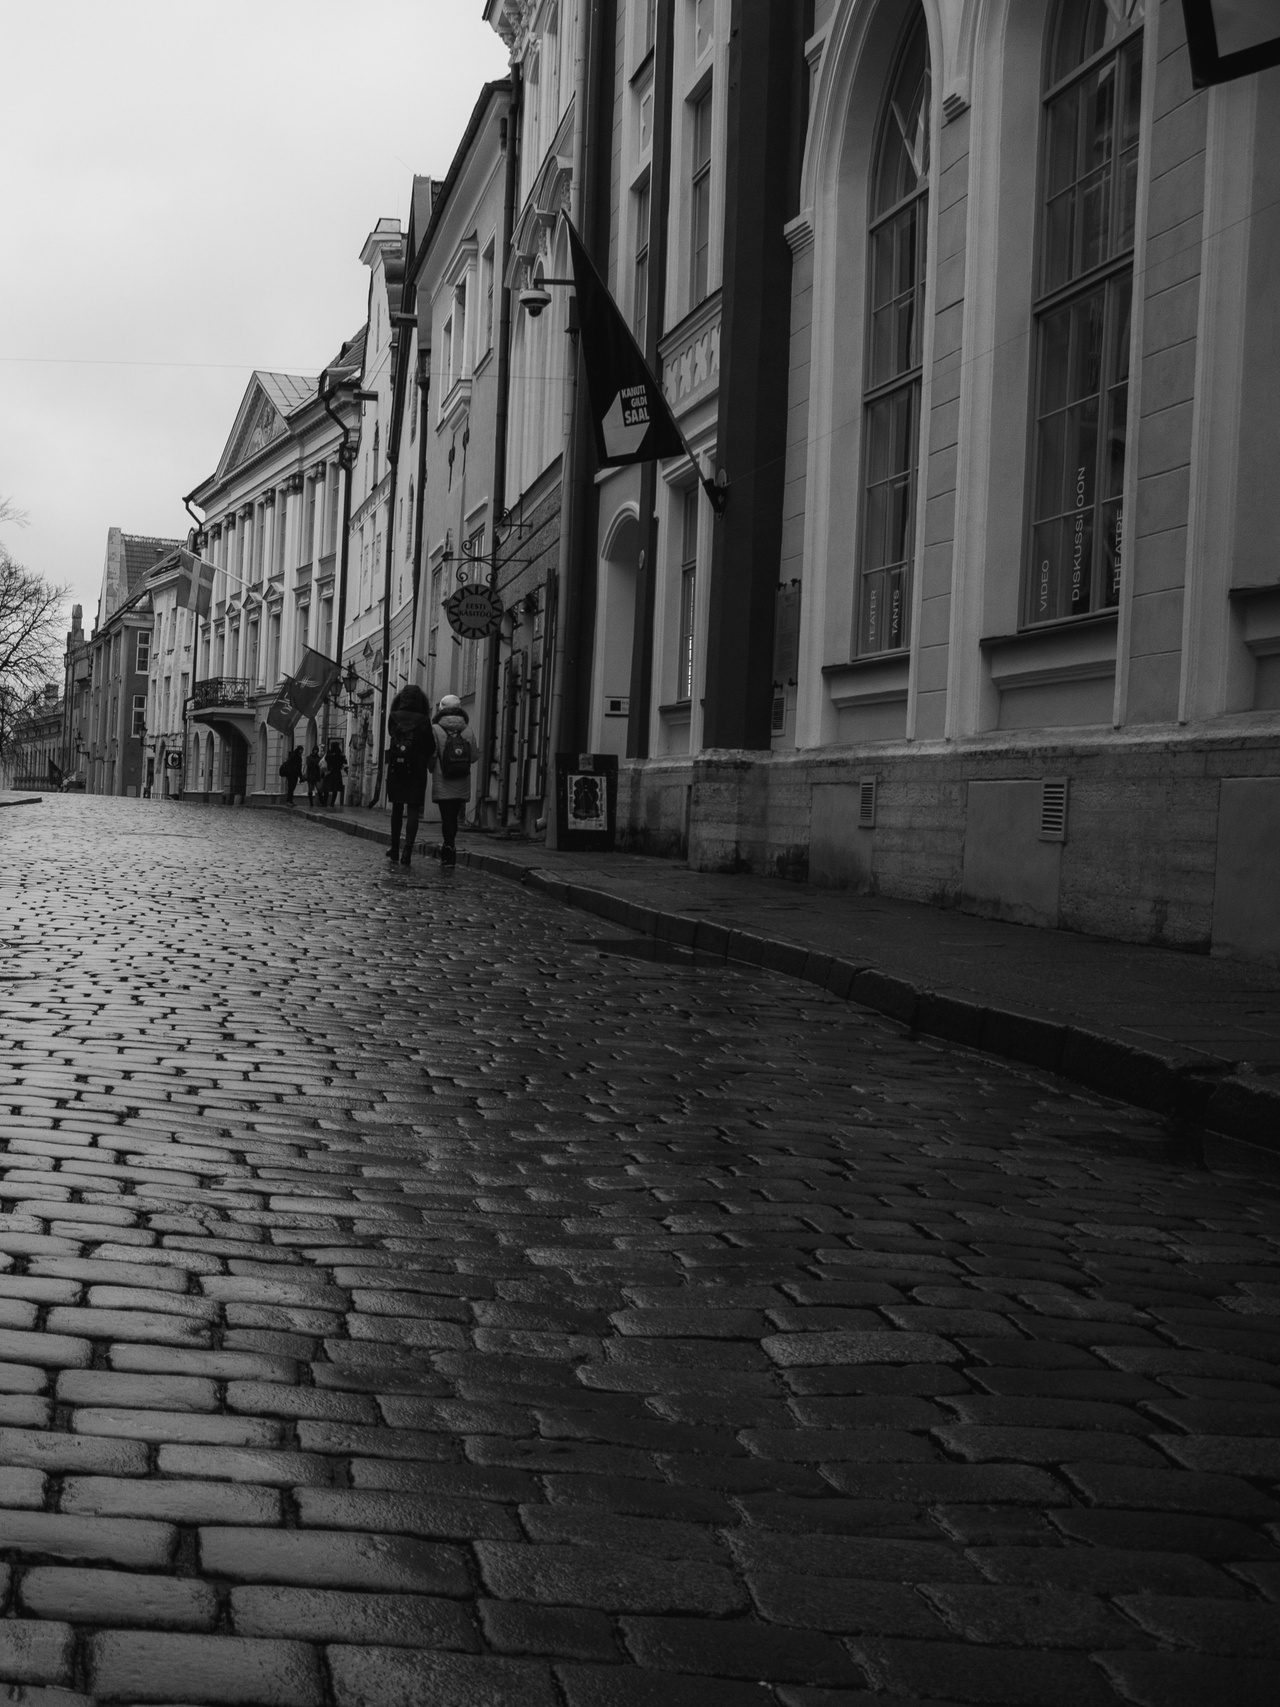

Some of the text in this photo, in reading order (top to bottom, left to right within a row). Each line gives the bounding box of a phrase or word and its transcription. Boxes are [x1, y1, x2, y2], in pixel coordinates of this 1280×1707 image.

[621, 384, 646, 399] KANUTI
[624, 407, 650, 424] SAAL
[630, 395, 648, 408] GILDI
[1113, 509, 1124, 594] THEATRE
[1039, 559, 1050, 612] VIDEO
[869, 589, 877, 643] TEATER
[891, 589, 900, 637] TANTS
